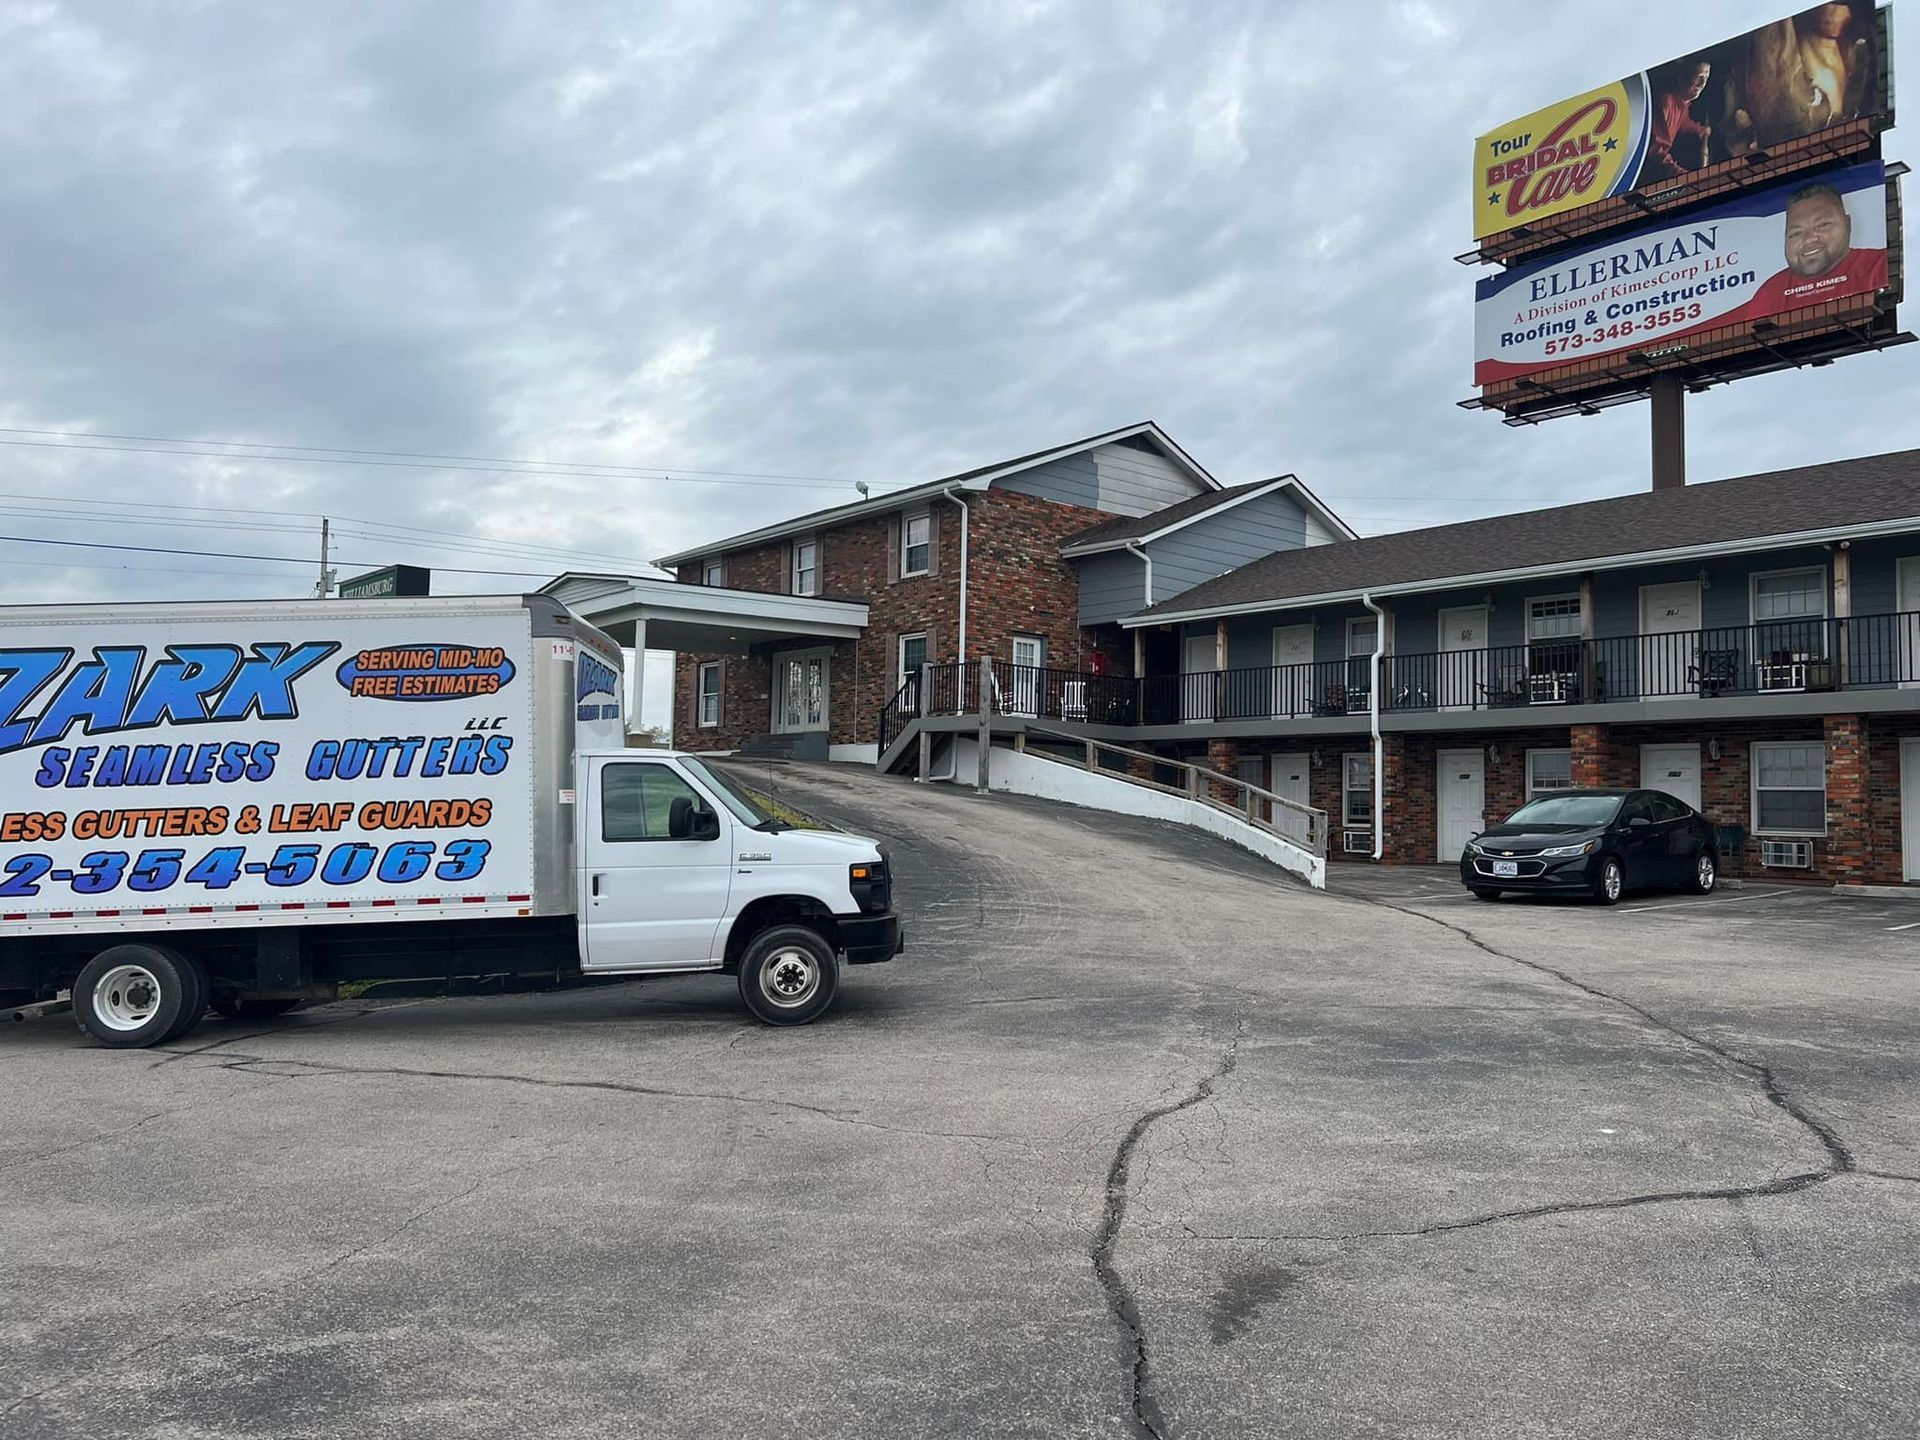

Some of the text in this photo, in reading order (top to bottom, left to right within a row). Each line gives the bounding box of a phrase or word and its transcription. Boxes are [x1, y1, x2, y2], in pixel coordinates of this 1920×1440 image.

[1486, 132, 1598, 188] BRIDAL
[1491, 133, 1531, 157] Tour
[1514, 252, 1739, 325] A Division of KimesCorp LLC
[1530, 226, 1718, 302] ELLERMAN
[1784, 283, 1814, 296] CHRIS
[1816, 275, 1848, 288] KIMES
[1501, 270, 1755, 347] Roofing & Construction
[1545, 303, 1702, 355] 573-348-3553
[350, 673, 501, 697] FREE ESTIMATES
[355, 647, 505, 671] SERVING MID-MO
[0, 641, 342, 754] ZARK
[464, 717, 508, 731] LLC
[35, 733, 513, 788] SEAMLESS GUTTERS
[72, 805, 229, 839] GUTTERS
[235, 804, 261, 834] &
[269, 800, 354, 834] LEAF
[358, 798, 492, 832] GUARDS
[0, 839, 492, 897] 2-354-5063
